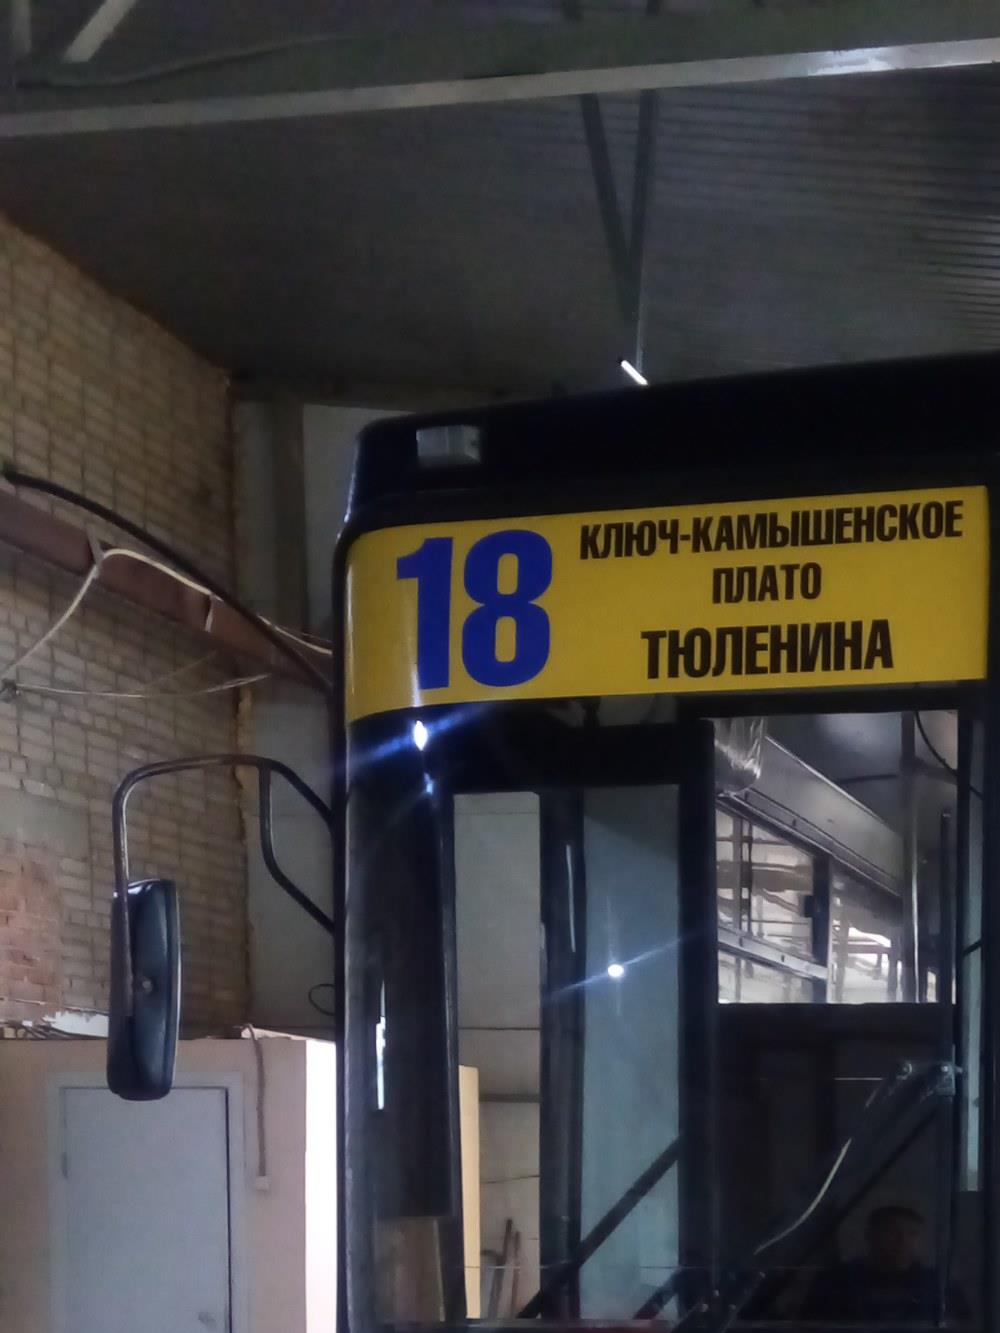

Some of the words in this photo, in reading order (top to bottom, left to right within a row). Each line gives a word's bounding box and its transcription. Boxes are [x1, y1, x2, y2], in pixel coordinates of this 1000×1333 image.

[579, 500, 963, 560] КЛЮЧ-КАМЫШЕНСКОЕ
[396, 529, 553, 690] 18
[712, 562, 822, 604] ПЛАТО
[641, 619, 893, 680] ТЮЛЕНИНА
